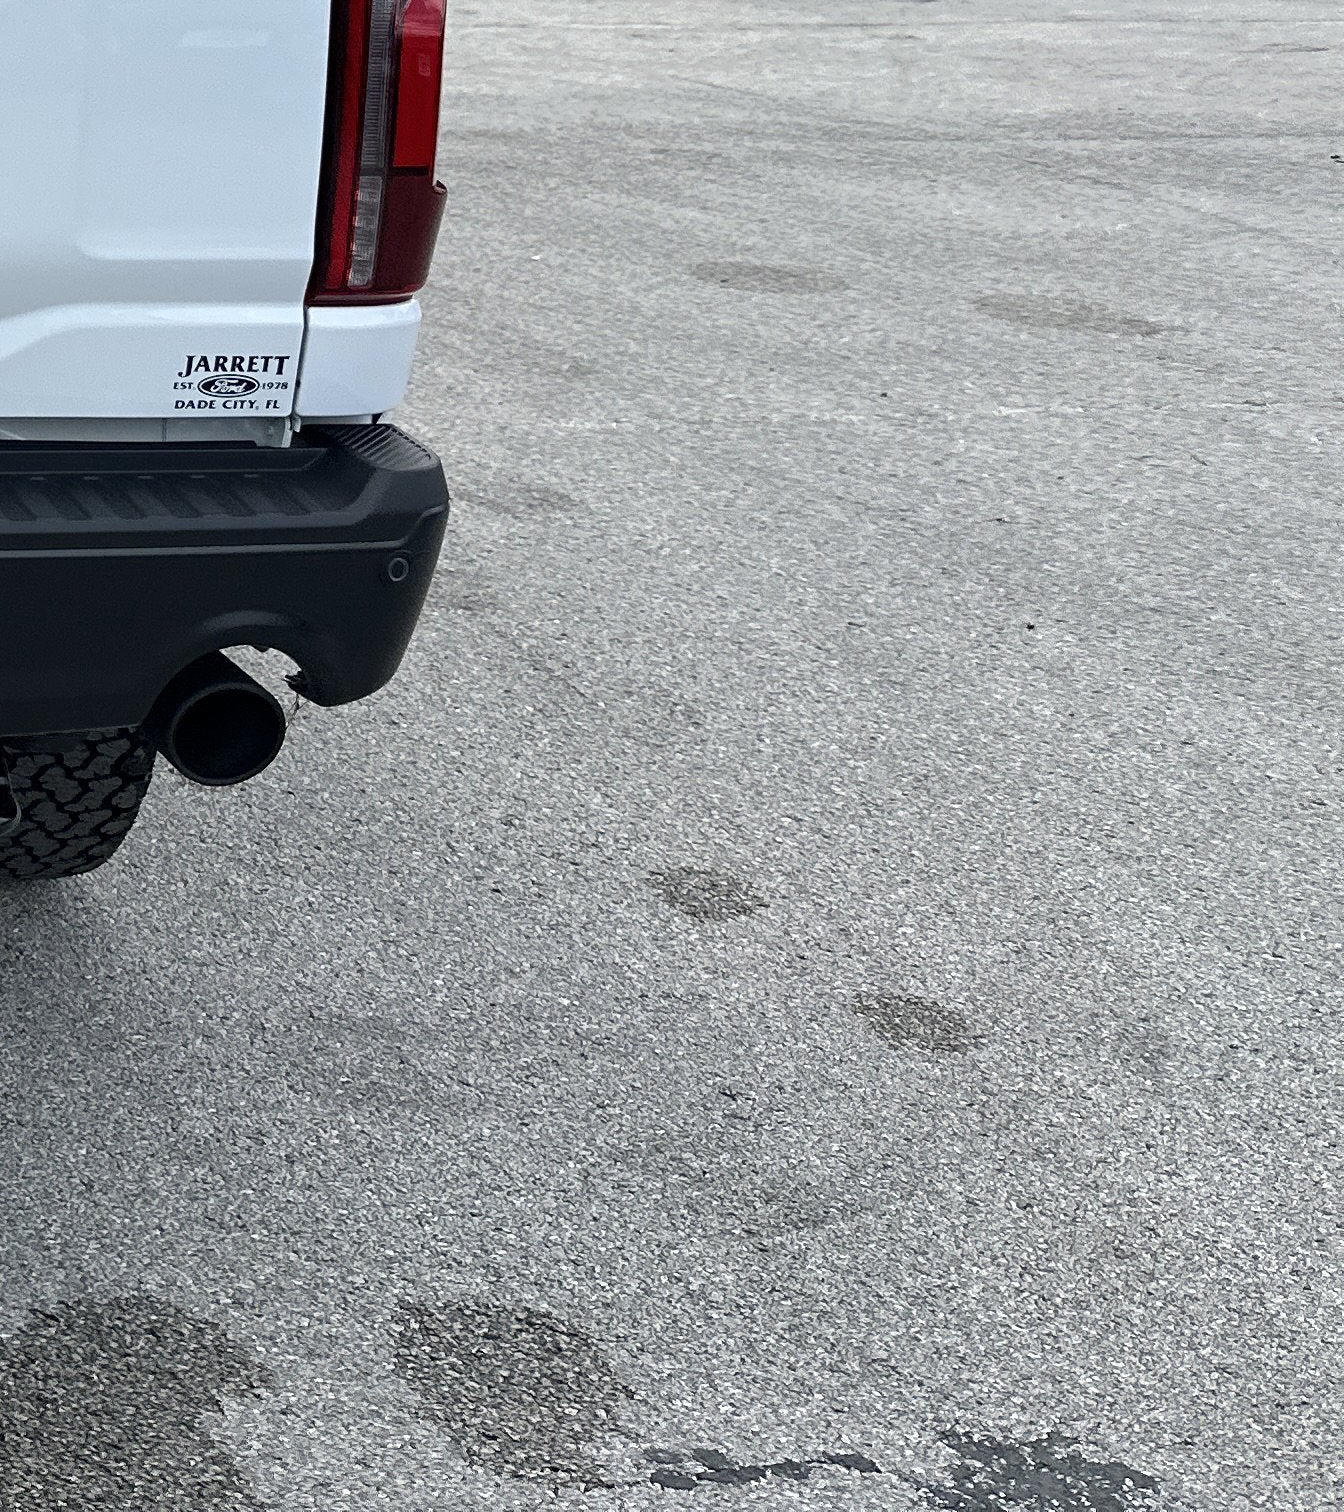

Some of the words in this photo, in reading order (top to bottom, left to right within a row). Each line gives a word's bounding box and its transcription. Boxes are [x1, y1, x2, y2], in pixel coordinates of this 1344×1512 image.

[177, 354, 291, 378] JARRETT
[210, 378, 248, 393] Ford
[174, 399, 217, 409] DADE
[222, 399, 260, 411] CITY,
[265, 399, 281, 409] FL
